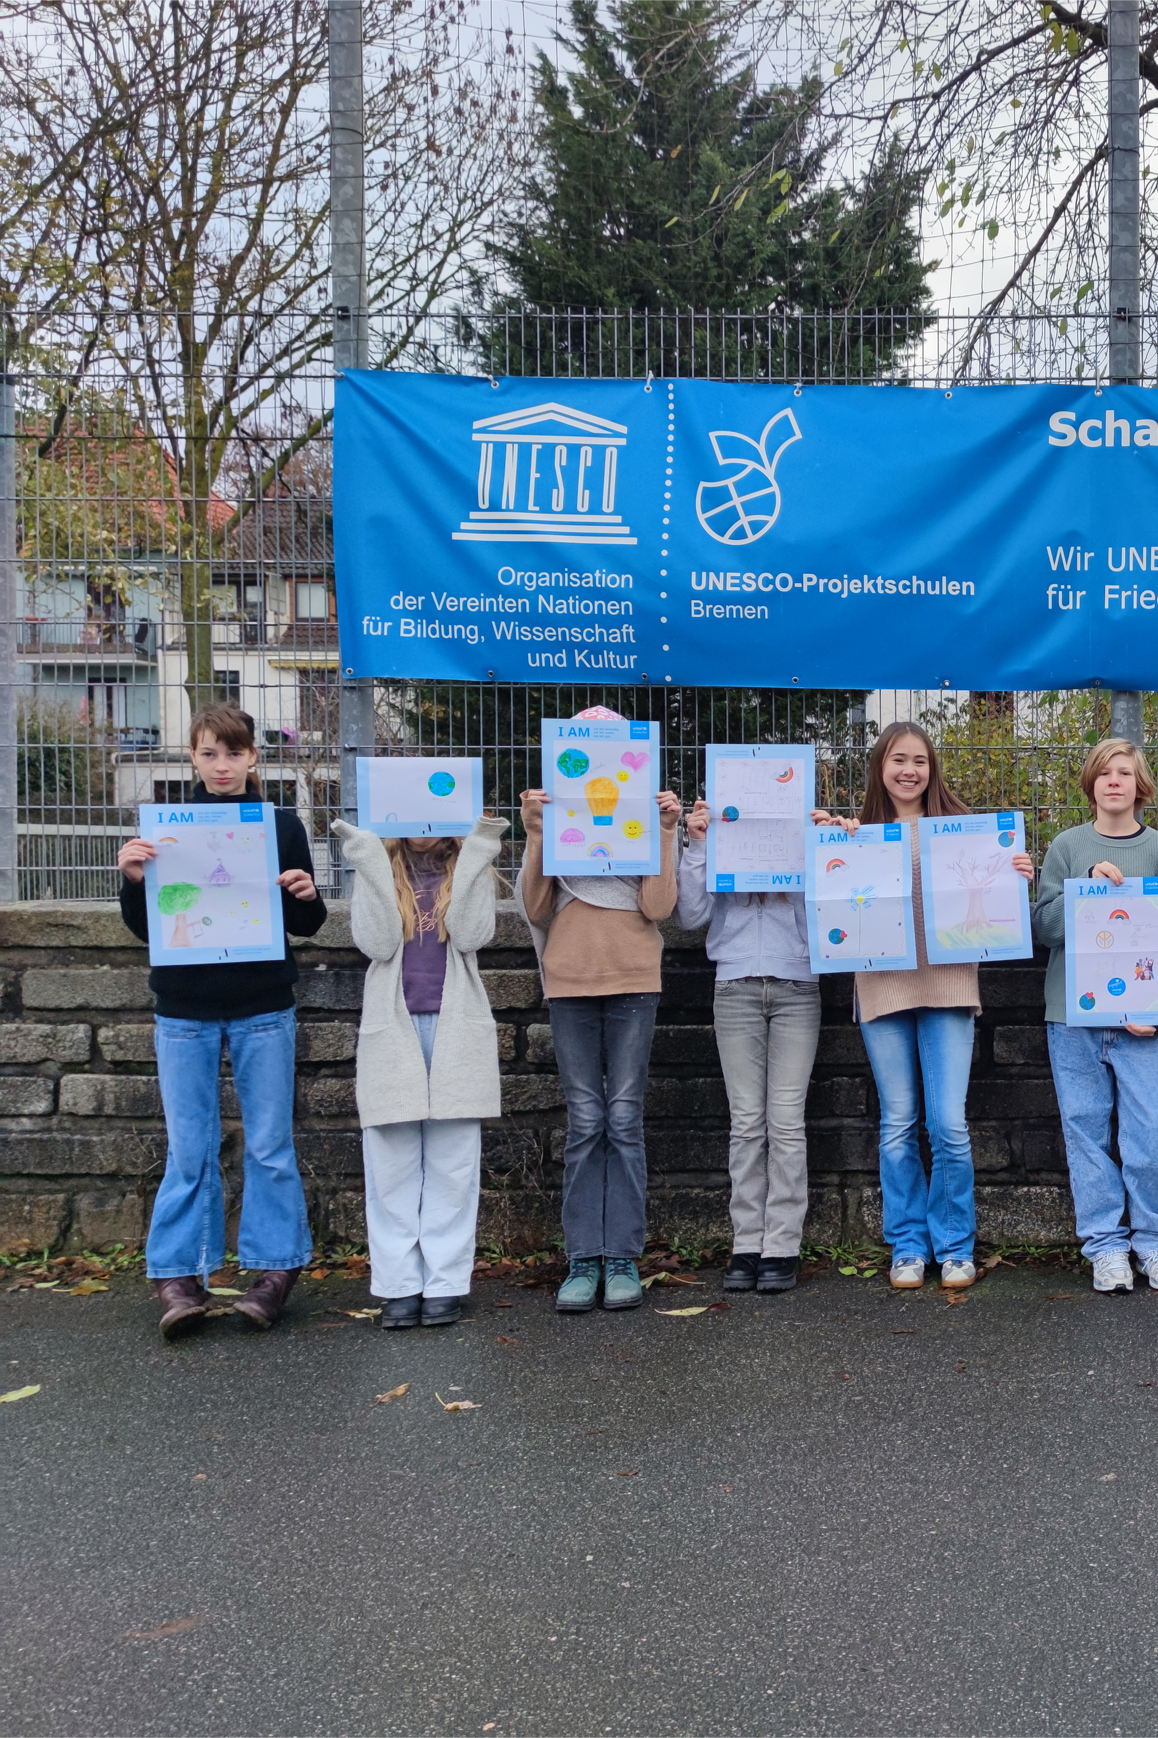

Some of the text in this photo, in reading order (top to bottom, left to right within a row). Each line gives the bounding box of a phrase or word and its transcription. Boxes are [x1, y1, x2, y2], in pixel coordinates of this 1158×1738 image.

[477, 442, 618, 513] UNESCO
[1046, 546, 1095, 571] Wir
[497, 566, 633, 591] Organisation
[690, 571, 975, 598] UNESCO-Projektschulen
[390, 591, 633, 616] der Vereinten Nationen
[1046, 583, 1087, 610] für
[690, 599, 769, 619] Bremen
[362, 615, 636, 645] für Bildung, Wissenschaft
[527, 649, 638, 669] und Kultur
[558, 726, 564, 737] I
[567, 727, 590, 737] AM
[157, 812, 164, 823] I
[168, 812, 194, 823] AM
[819, 833, 824, 843] I
[828, 832, 848, 843] AM
[933, 824, 938, 834] I
[942, 823, 962, 833] AM
[772, 875, 792, 885] AM
[796, 875, 801, 885] I
[1079, 886, 1084, 895] I
[1087, 885, 1107, 895] AM
